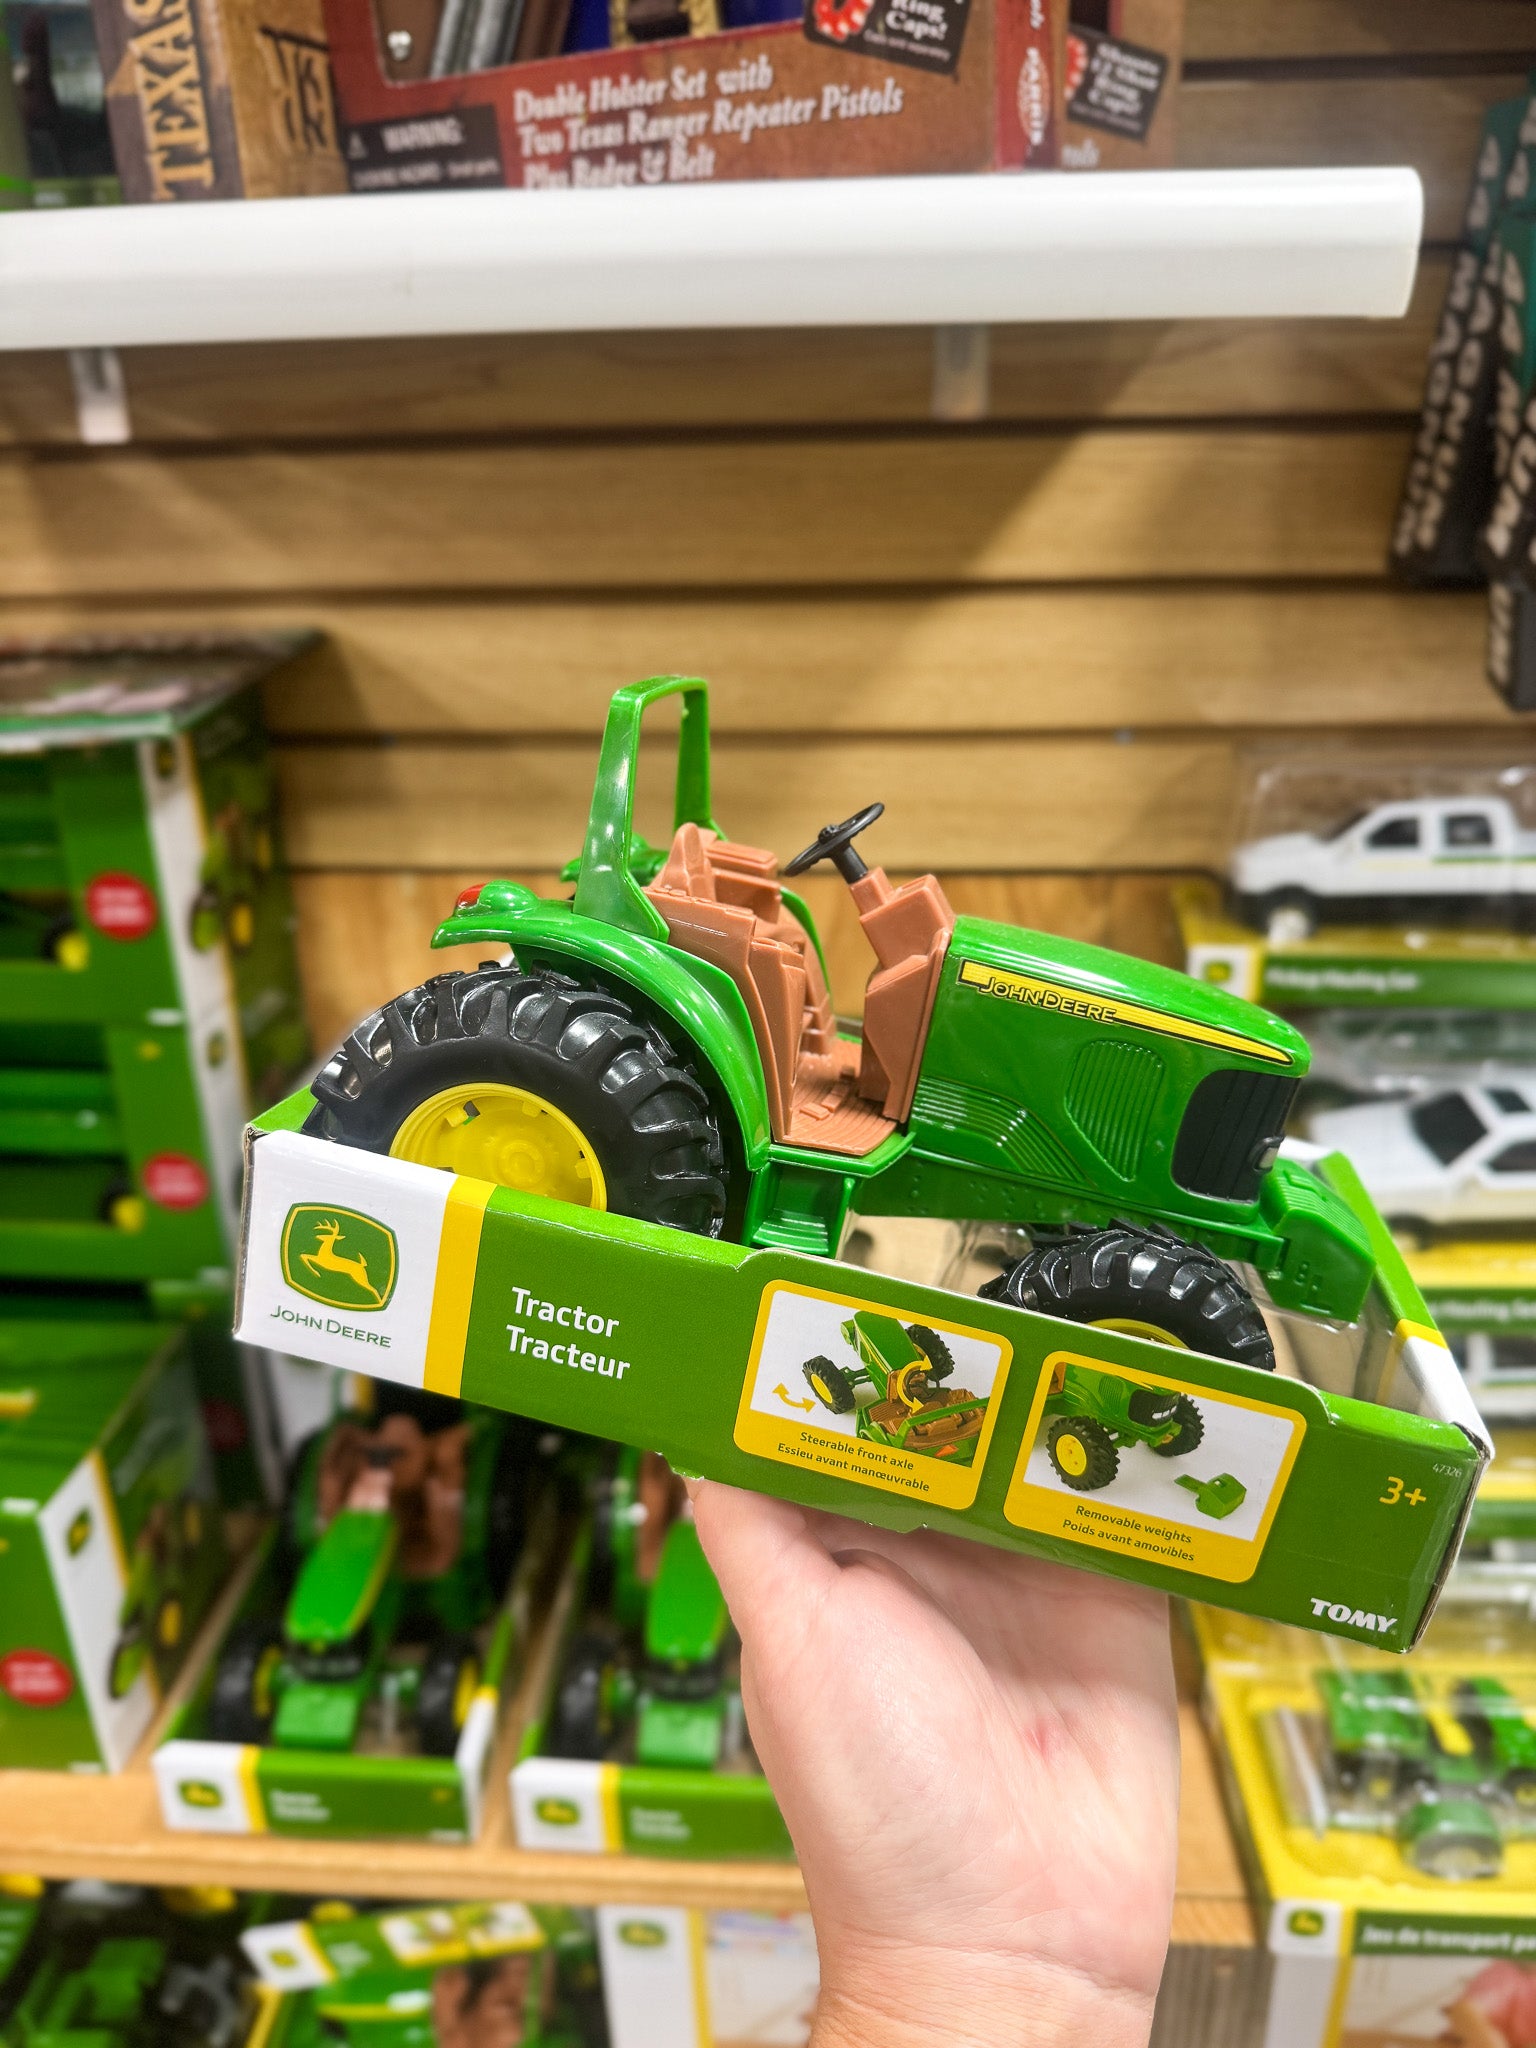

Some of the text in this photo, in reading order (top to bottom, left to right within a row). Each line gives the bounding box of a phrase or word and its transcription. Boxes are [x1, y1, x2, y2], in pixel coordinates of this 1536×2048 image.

[514, 53, 774, 122] Double Holster Set with
[518, 122, 565, 157] Two
[627, 109, 711, 147] Ranger
[712, 97, 818, 144] Repeater
[820, 76, 905, 121] Pistols
[668, 138, 716, 181] Belt
[980, 977, 1117, 1023] JOHN DEERE
[270, 1305, 391, 1348] JOHN DEERE
[511, 1286, 620, 1338] Tractor
[505, 1324, 631, 1380] Tracteur
[777, 1442, 930, 1492] Essieu avant manœuvrable
[800, 1431, 914, 1471] Steerable front axle
[1432, 1463, 1463, 1479] 47326
[1378, 1475, 1427, 1507] 3+
[1062, 1518, 1195, 1562] Poids avant amovibles
[1075, 1504, 1193, 1544] Removable weights
[1310, 1597, 1398, 1634] TOMY
